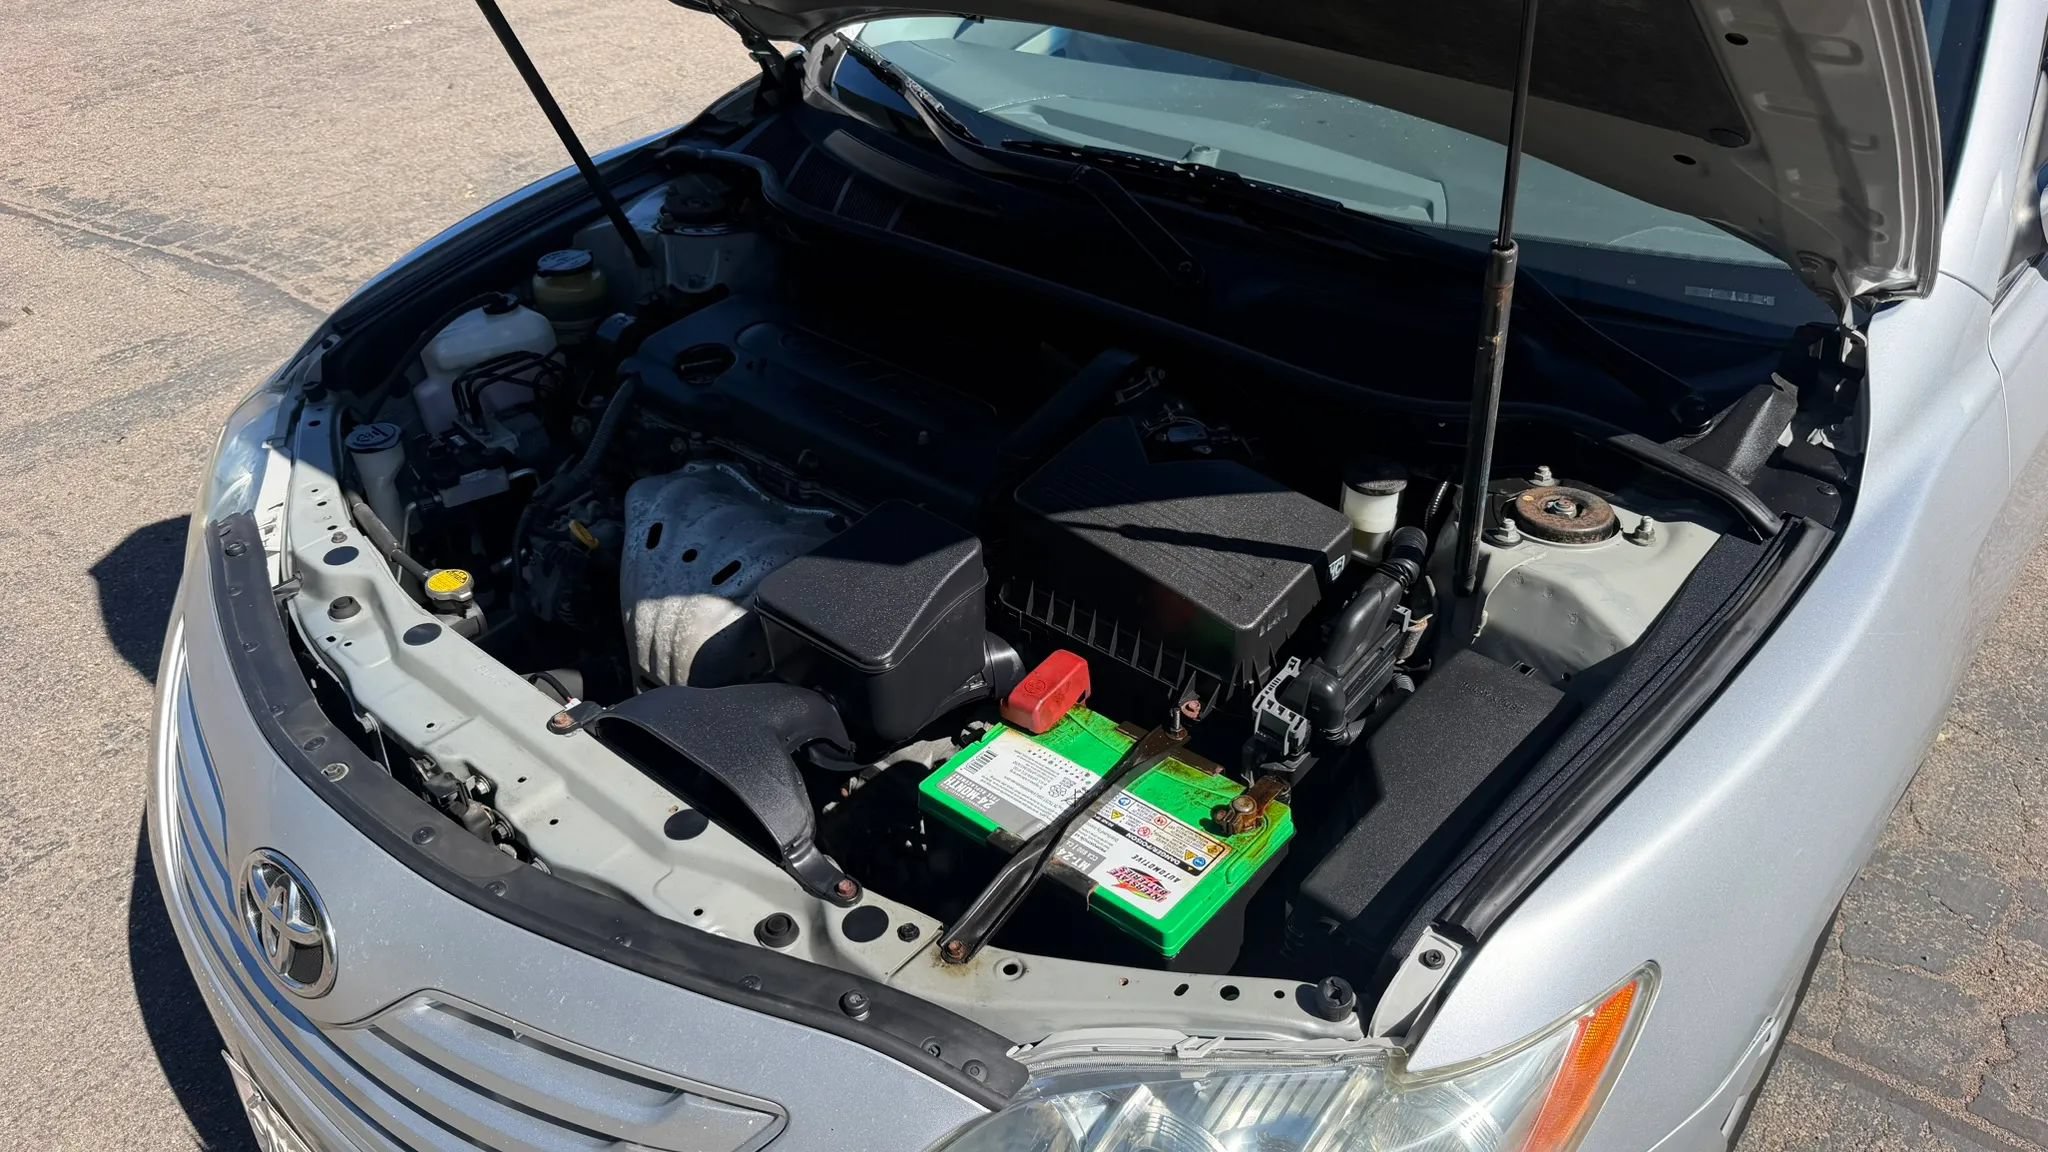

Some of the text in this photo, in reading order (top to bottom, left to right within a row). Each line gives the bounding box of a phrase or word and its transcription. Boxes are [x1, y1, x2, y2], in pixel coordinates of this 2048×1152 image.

[942, 775, 996, 809] 24-MONTH
[1125, 832, 1181, 865] DANGER/POISON
[1119, 866, 1172, 896] BATTERIES
[1131, 854, 1181, 883] AUTOMOTIVE
[1106, 868, 1167, 903] INTERSTATE
